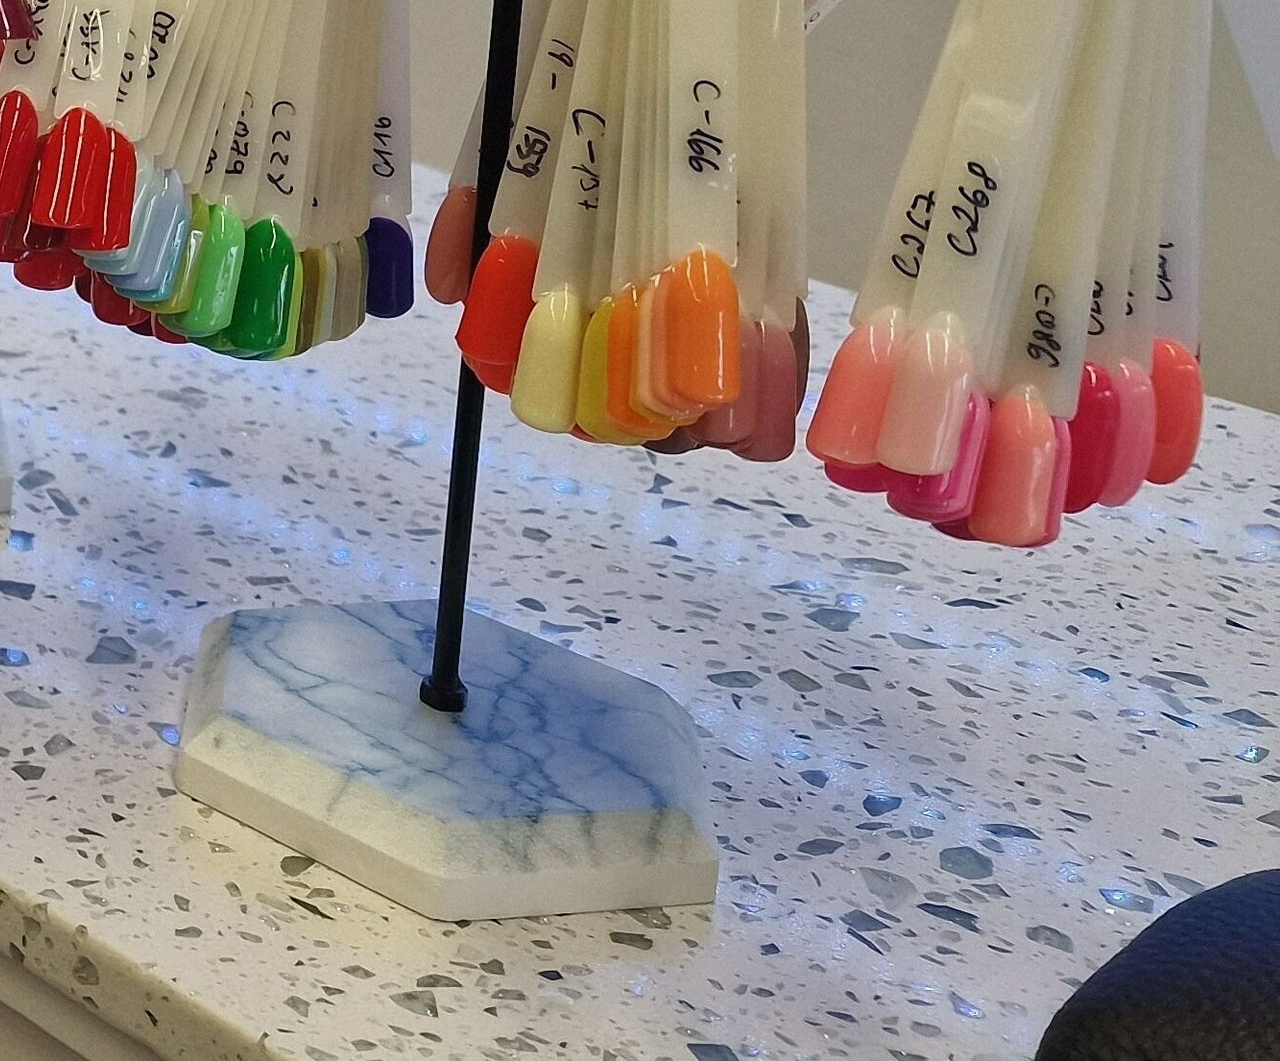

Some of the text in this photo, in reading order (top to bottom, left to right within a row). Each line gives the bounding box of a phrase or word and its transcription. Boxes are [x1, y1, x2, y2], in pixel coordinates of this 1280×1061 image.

[372, 116, 395, 178] C116
[687, 80, 723, 172] C-166
[891, 190, 935, 279] C267
[947, 161, 998, 257] C268
